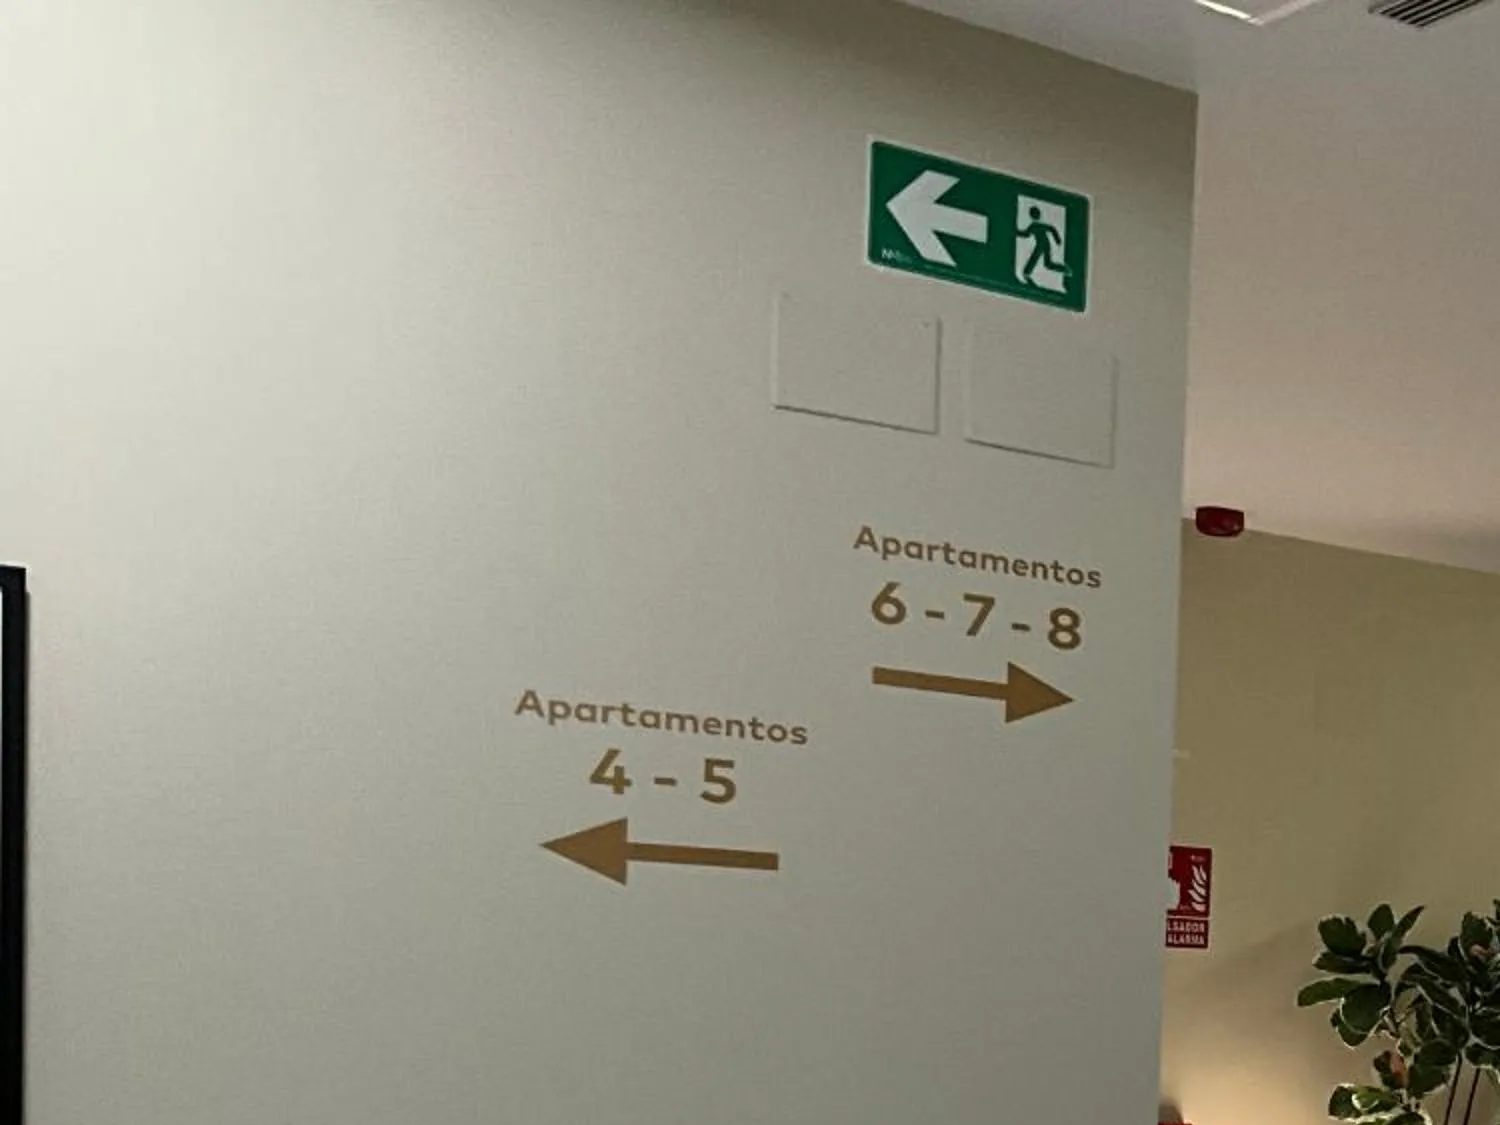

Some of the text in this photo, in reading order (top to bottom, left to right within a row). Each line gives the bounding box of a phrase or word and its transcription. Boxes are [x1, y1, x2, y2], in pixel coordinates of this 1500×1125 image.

[852, 524, 1102, 589] Apartamentos
[870, 580, 907, 626] 6
[962, 591, 997, 638] 7
[1046, 607, 1083, 651] 8
[513, 688, 809, 746] Apartamentos
[588, 747, 633, 796] 4
[699, 757, 738, 805] 5
